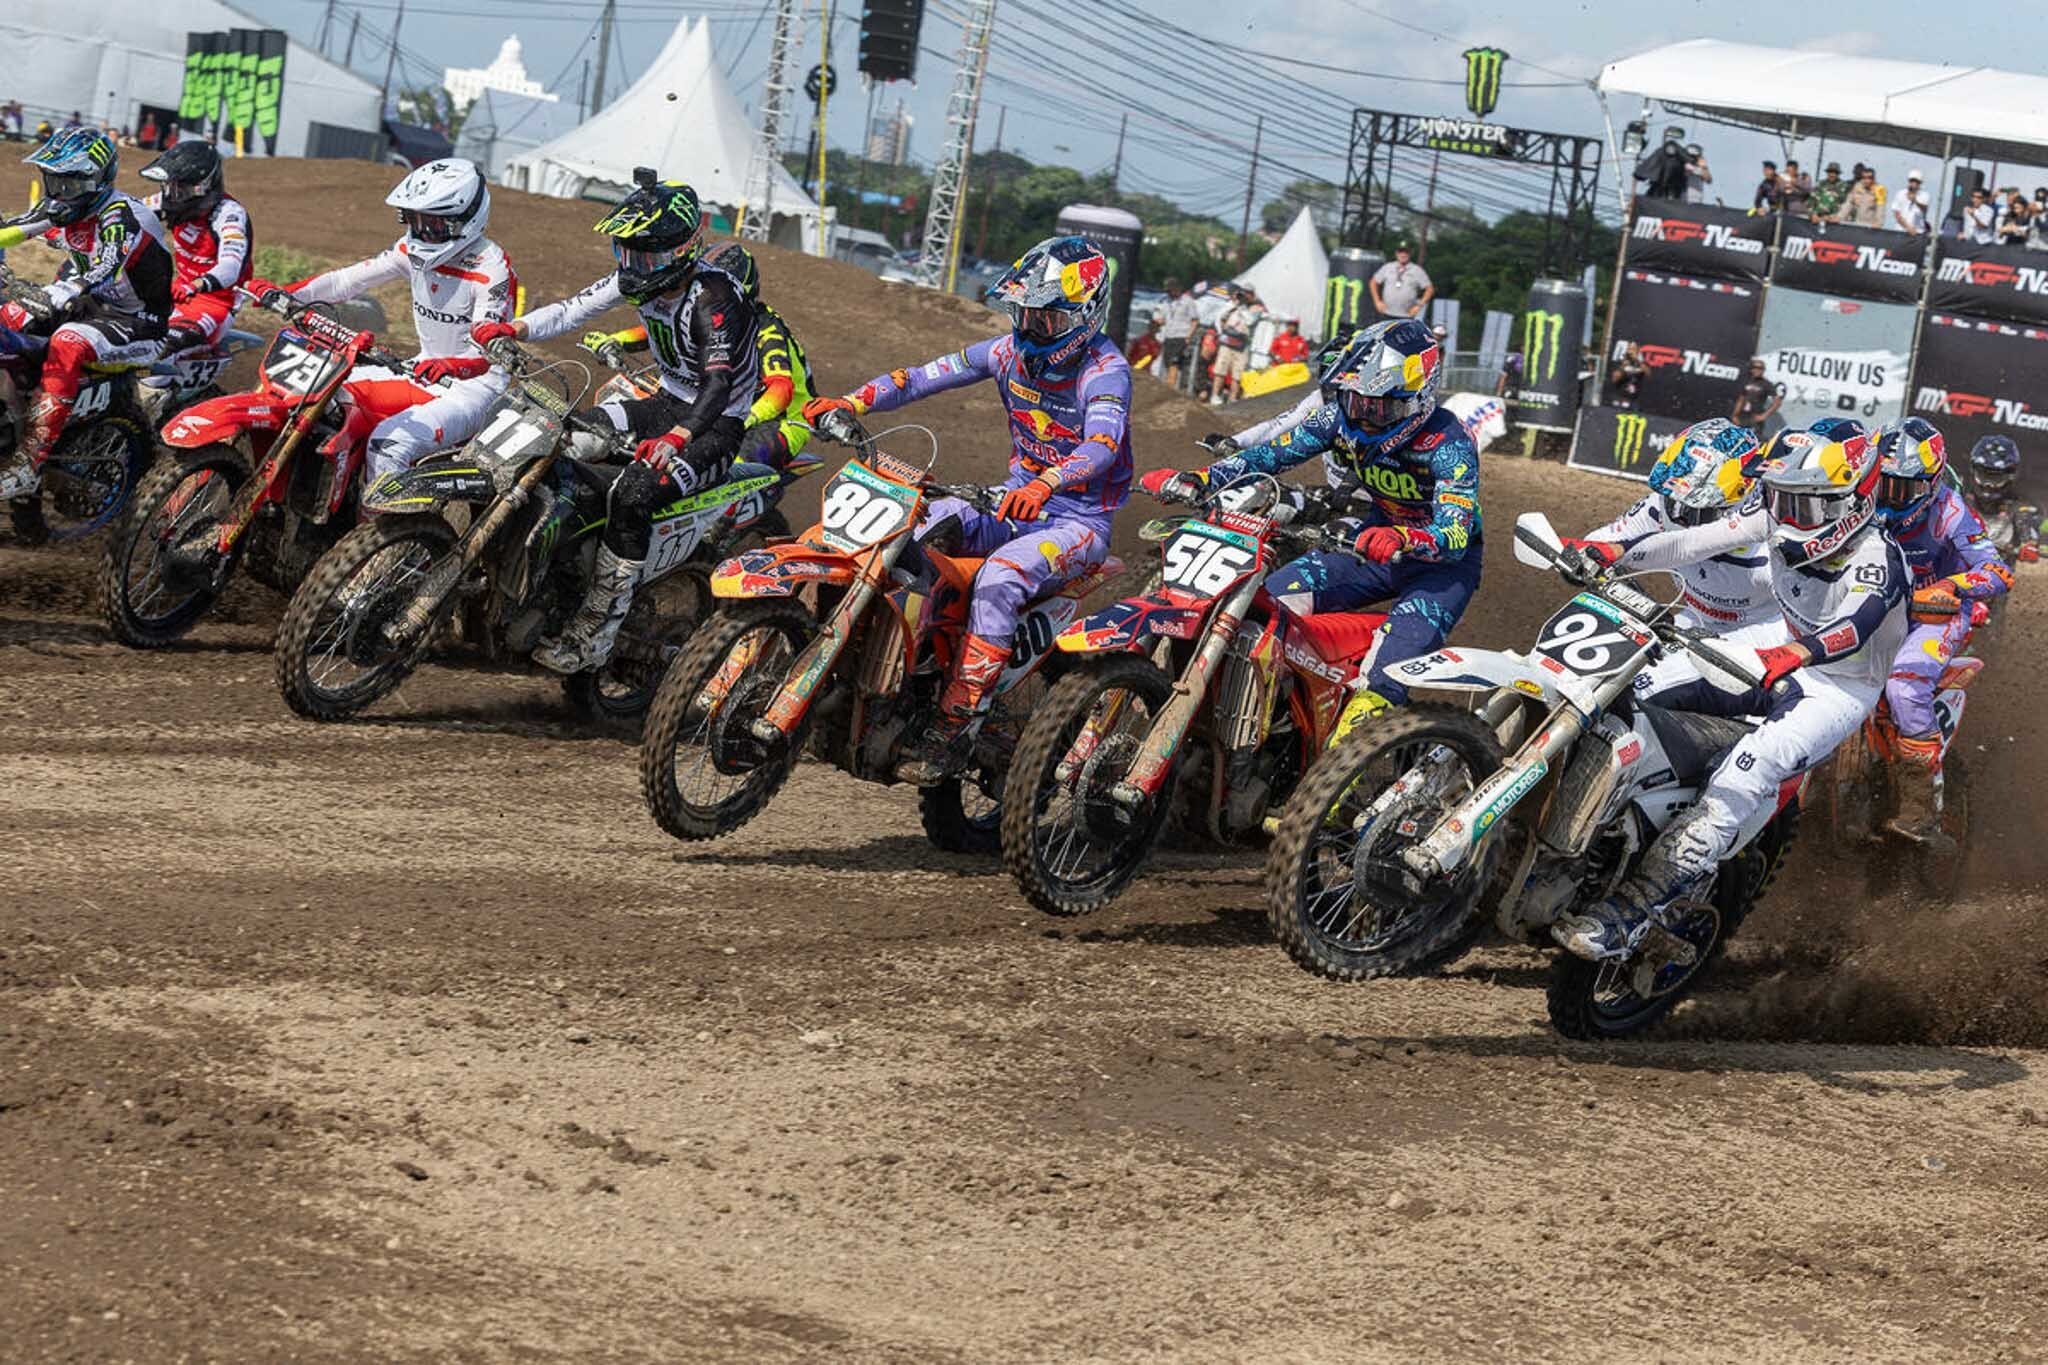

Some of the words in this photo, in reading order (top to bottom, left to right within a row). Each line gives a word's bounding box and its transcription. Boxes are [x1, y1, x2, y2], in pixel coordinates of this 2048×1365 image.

[1418, 117, 1507, 145] MONSTER
[414, 302, 473, 324] ONDA
[183, 360, 220, 388] 33
[265, 343, 334, 393] 73
[1777, 351, 1853, 382] FOLLOW
[1858, 362, 1886, 388] US
[71, 381, 111, 417] 44
[476, 408, 544, 460] 11
[1365, 464, 1424, 500] HOR
[824, 482, 904, 544] 80
[1163, 533, 1255, 597] 516
[1009, 611, 1053, 669] 80
[1536, 613, 1631, 670] 96
[1284, 643, 1346, 684] GASGAS
[1494, 763, 1545, 815] MOTOREX
